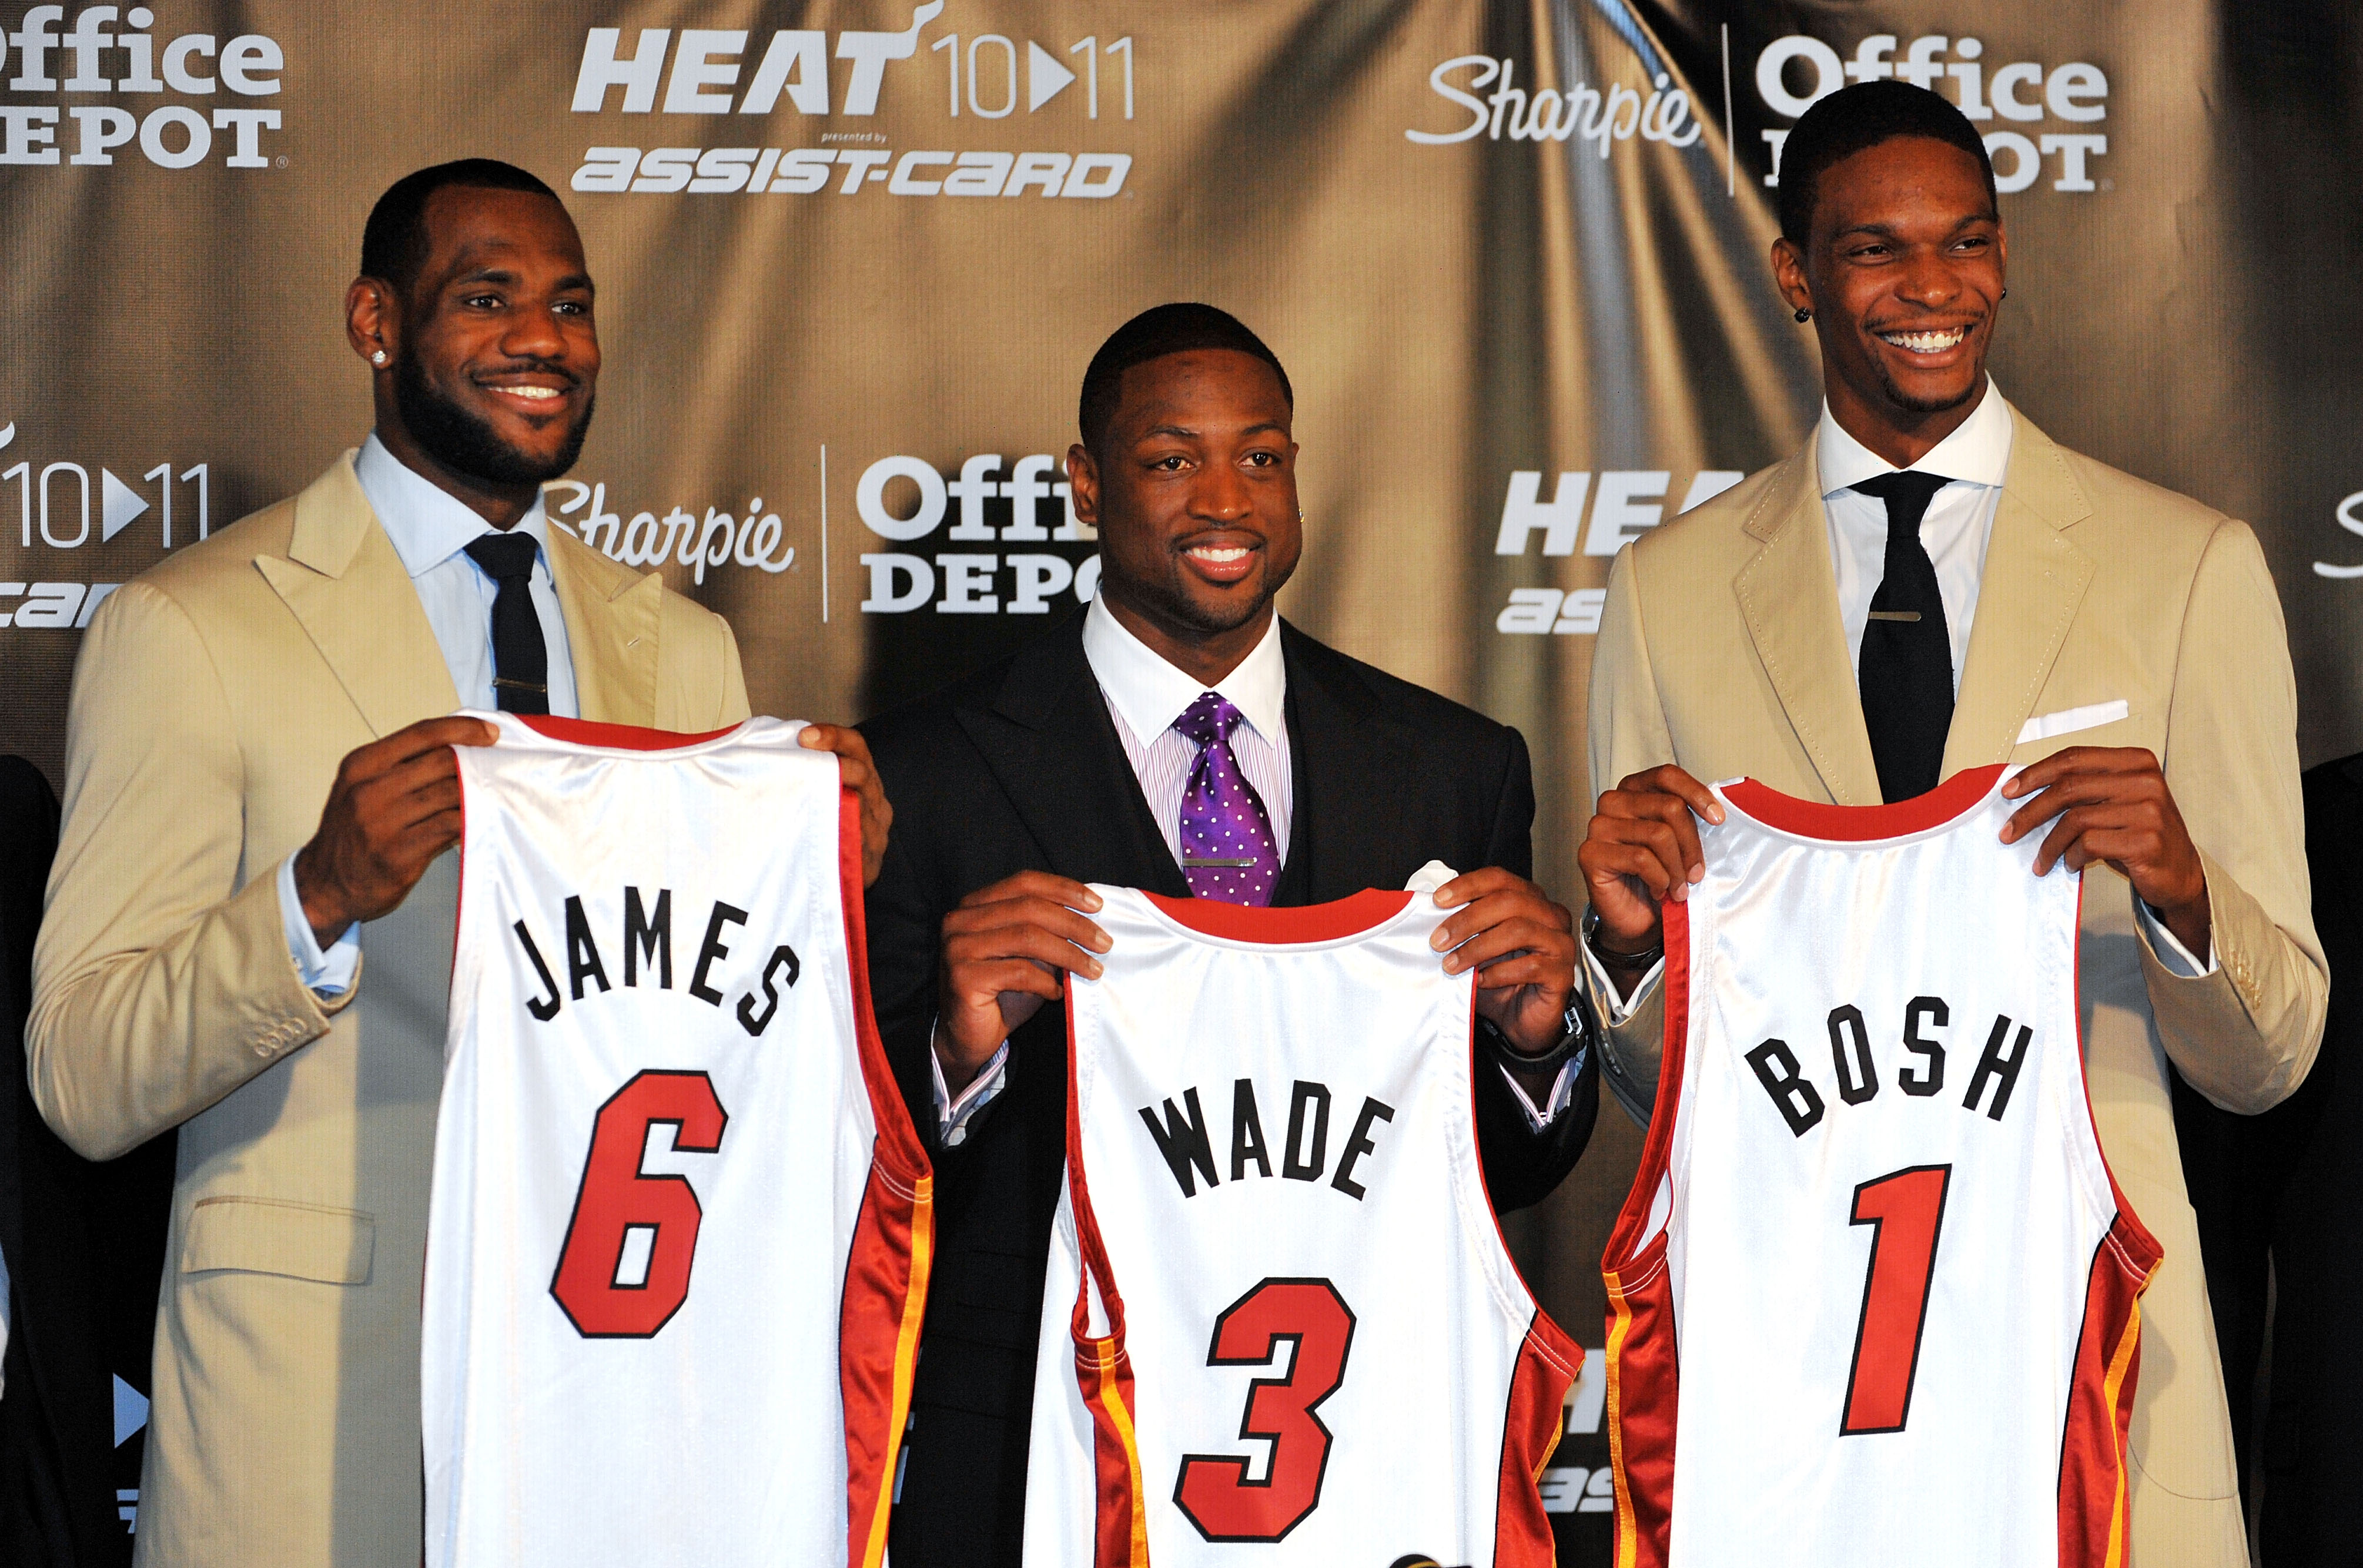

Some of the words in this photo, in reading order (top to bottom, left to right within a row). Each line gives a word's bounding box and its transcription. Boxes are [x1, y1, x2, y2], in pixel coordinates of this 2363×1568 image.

[0, 5, 284, 96] ffice
[570, 0, 943, 116] HEAT
[931, 33, 1017, 119] 10
[0, 106, 282, 169] EPOT
[821, 132, 873, 144] presented
[873, 132, 887, 145] by
[1405, 55, 1702, 160] Sharpie
[1, 461, 89, 548] 10
[1495, 471, 1745, 556] HE
[860, 553, 1101, 614] DEP
[513, 885, 800, 1037] JAMES
[1744, 996, 2033, 1138] BOSH
[1138, 1078, 1395, 1201] WADE
[549, 1068, 729, 1339] 6
[1839, 1162, 1952, 1436] 1
[1172, 1276, 1357, 1544] 3
